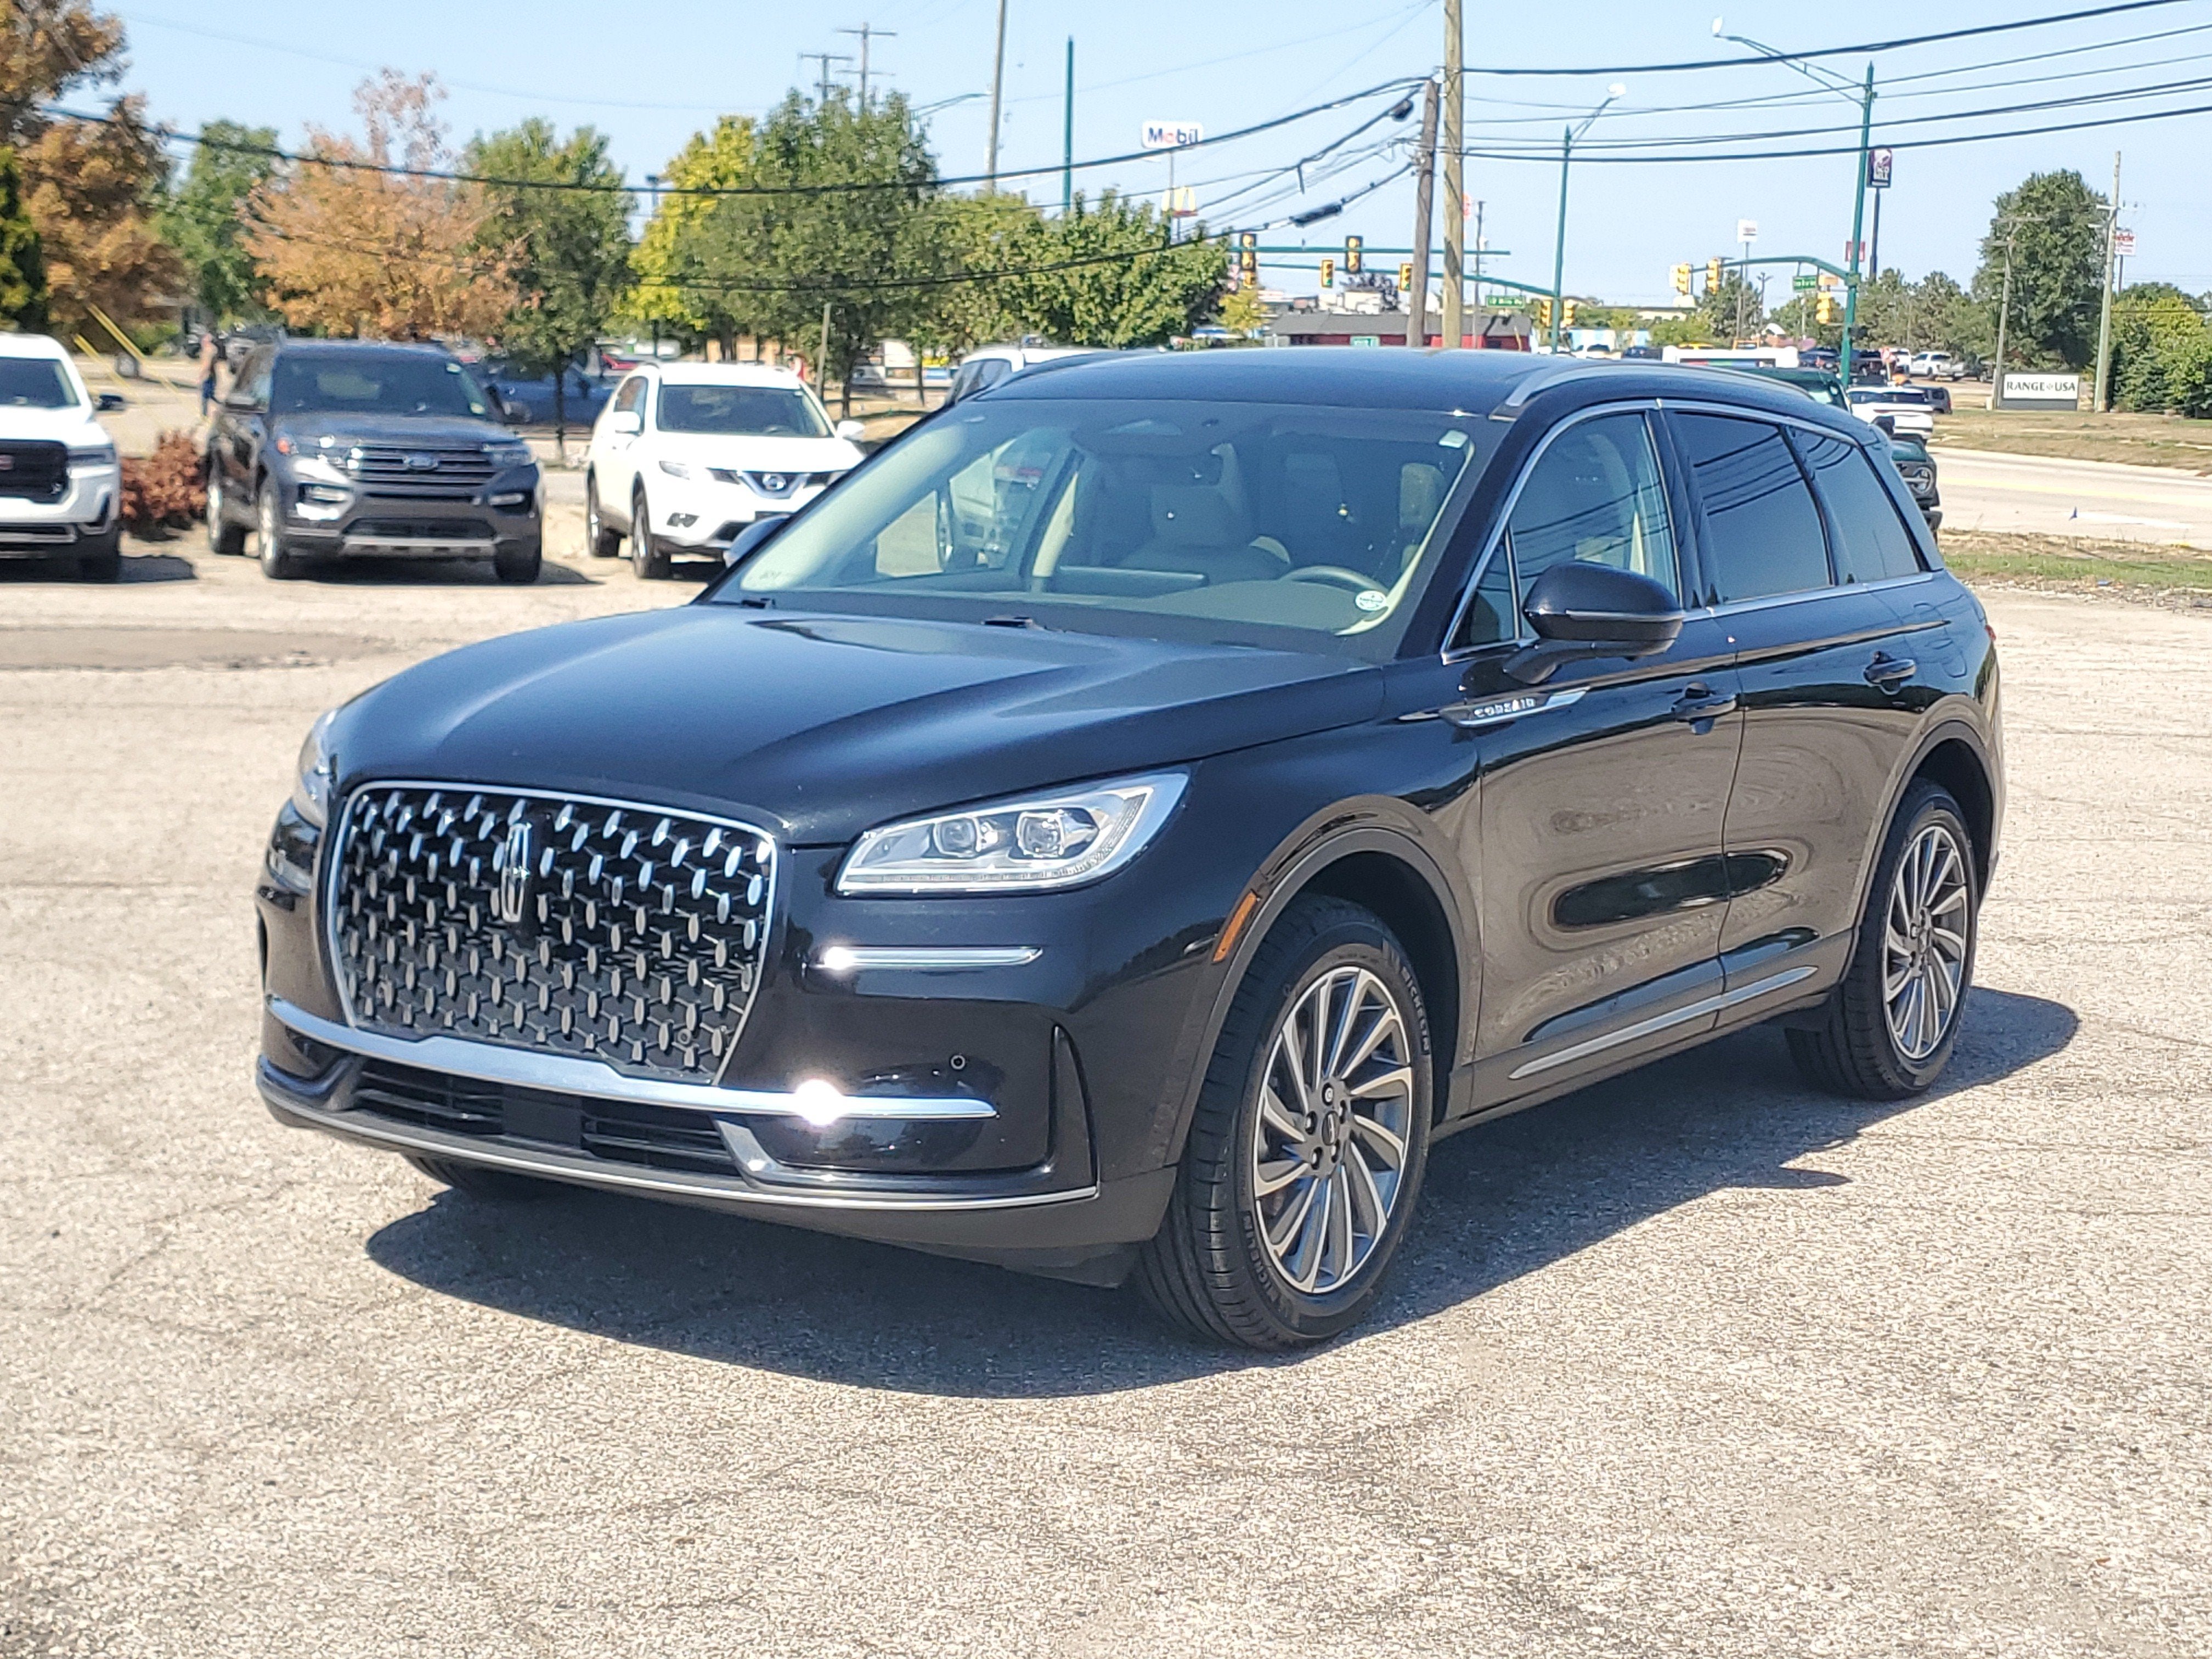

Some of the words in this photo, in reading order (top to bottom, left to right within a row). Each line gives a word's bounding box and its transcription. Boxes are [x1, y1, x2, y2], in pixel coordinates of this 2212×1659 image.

[1148, 127, 1198, 144] Mobil
[2007, 381, 2045, 391] RANGE
[2055, 382, 2075, 392] USA
